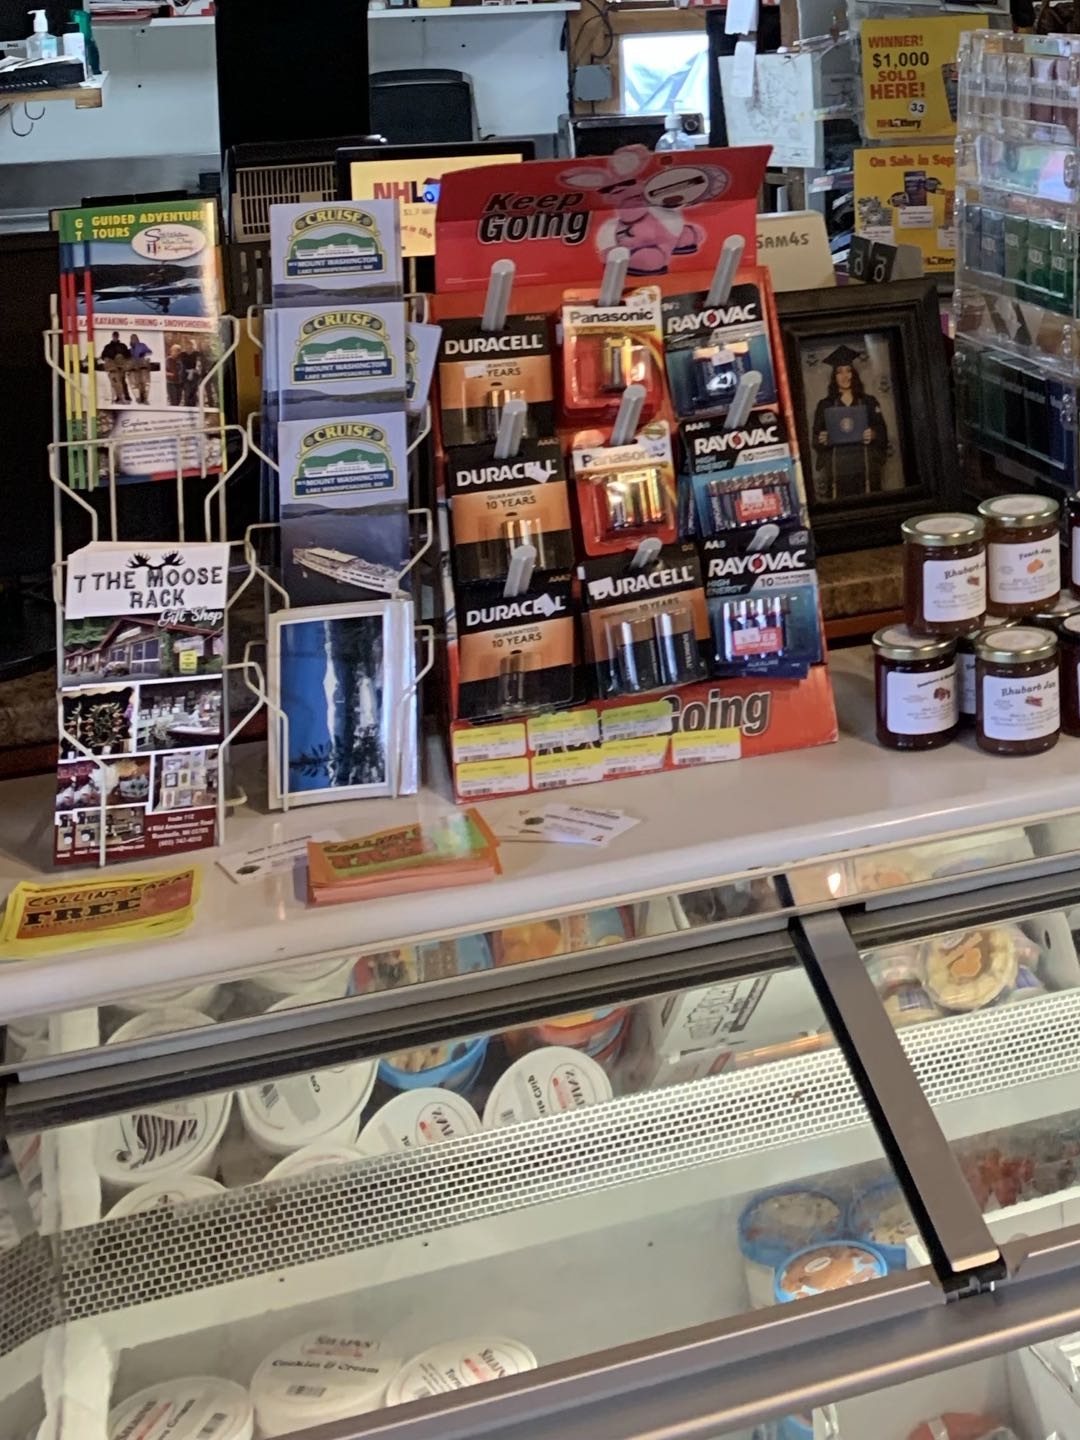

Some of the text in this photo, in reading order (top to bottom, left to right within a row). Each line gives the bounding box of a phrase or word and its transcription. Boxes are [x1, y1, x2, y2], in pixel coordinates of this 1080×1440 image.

[868, 35, 924, 49] WINNER!
[872, 51, 930, 70] $1,000
[878, 70, 917, 82] SOLD
[870, 83, 926, 100] HERE!
[910, 103, 925, 114] 33
[869, 157, 886, 167] On
[890, 155, 914, 167] Sale
[485, 191, 584, 214] Keep
[92, 213, 135, 226] GUIDED
[305, 210, 362, 225] CRUISE
[92, 227, 130, 239] TOURS
[479, 210, 591, 245] Going
[298, 257, 327, 268] MOUNT
[313, 313, 371, 329] CRUISE
[569, 308, 654, 324] Panasonic
[667, 303, 756, 335] RAYOVAC
[445, 334, 543, 356] DURACELL
[305, 362, 334, 373] MOUNT
[487, 366, 522, 378] YEARS
[314, 424, 372, 440] CRUISE
[694, 425, 779, 456] RAYOVAC
[306, 477, 335, 487] MOUNT
[486, 496, 537, 510] 10 YEARS
[708, 549, 807, 578] RAYOVAC
[91, 565, 224, 591] THE MOOSE
[944, 563, 981, 581] Rhubarb
[761, 578, 774, 588] 10
[129, 588, 187, 611] RACK
[157, 606, 224, 628] Gift Shop
[491, 633, 542, 650] 10 YEARS
[1001, 681, 1042, 698] Rhubarb
[22, 896, 142, 927] FREE
